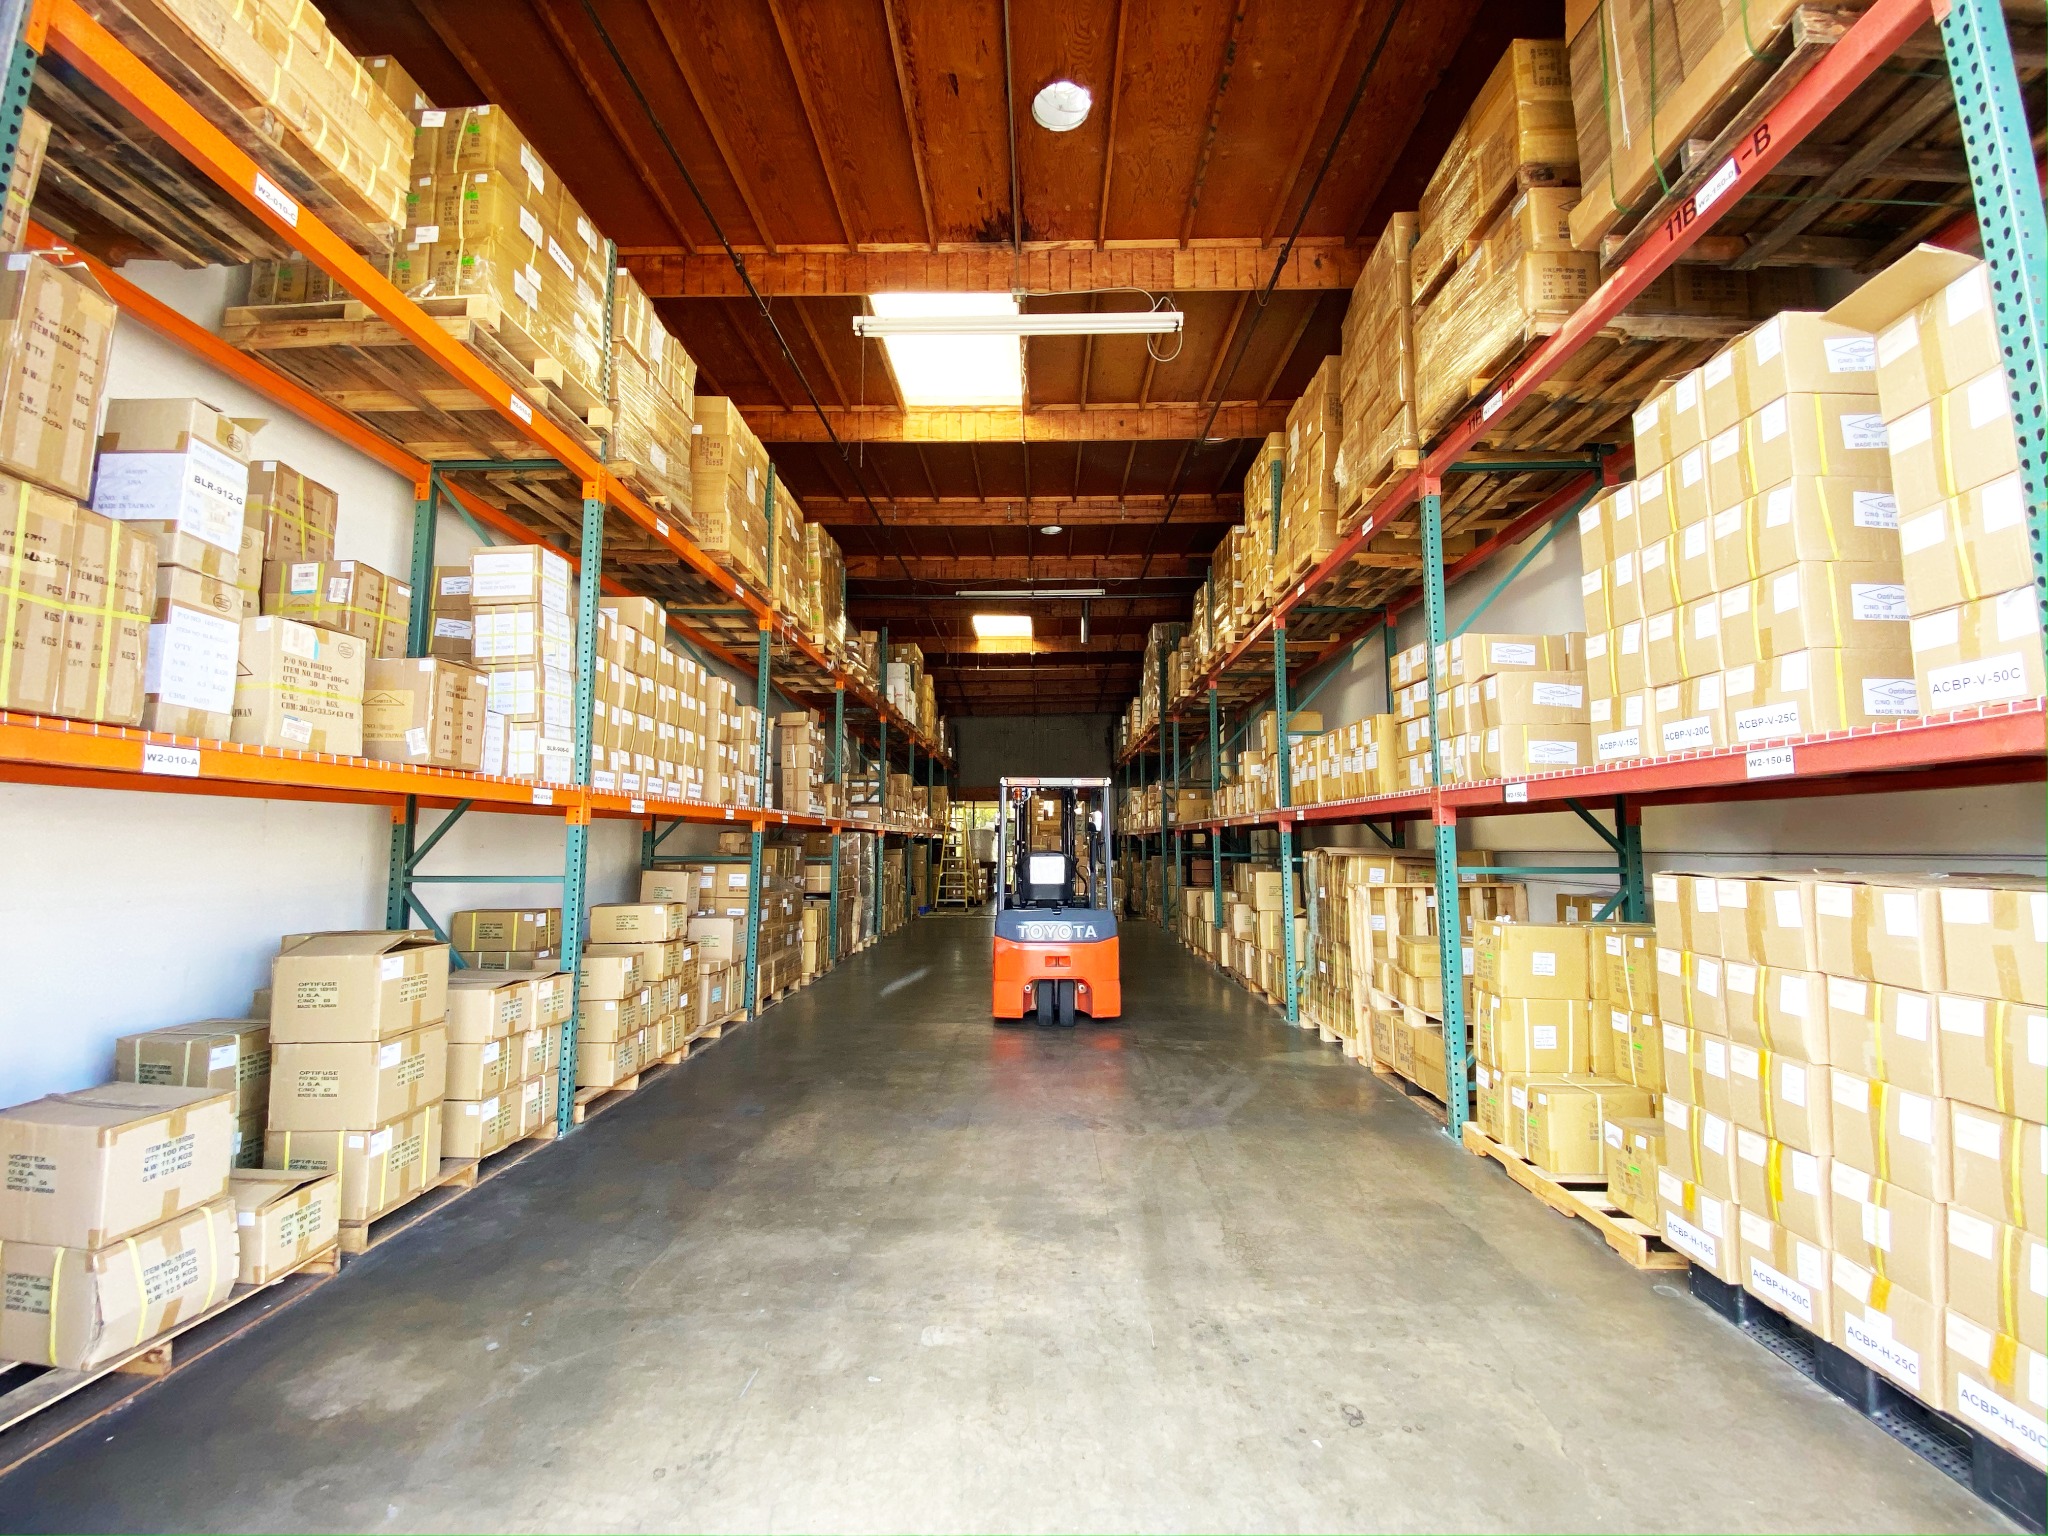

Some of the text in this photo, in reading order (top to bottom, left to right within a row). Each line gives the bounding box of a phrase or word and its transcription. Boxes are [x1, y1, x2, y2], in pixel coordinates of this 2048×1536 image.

[194, 475, 243, 505] BLR-912-G
[47, 584, 63, 596] PCS
[44, 611, 60, 622] KGS
[42, 636, 57, 646] KGS
[283, 665, 300, 675] ITEM
[1932, 668, 2021, 694] ACBP-V-50C
[1738, 713, 1797, 730] ACBP-V-25C
[1665, 726, 1710, 741] ACBP-V-20C
[1599, 737, 1638, 750] ACBP-V-15C
[147, 752, 198, 766] W2-010-A
[1749, 754, 1791, 767] W2-150-B
[1016, 924, 1097, 939] TOYOTA
[145, 1145, 161, 1154] ITEM
[163, 1148, 177, 1157] 100
[178, 1142, 194, 1152] PCS
[9, 1154, 46, 1162] VORTEX
[161, 1157, 176, 1167] 11.5
[178, 1151, 193, 1161] KGS
[177, 1160, 192, 1170] KGS
[297, 1214, 308, 1223] 100
[1668, 1221, 1714, 1256] ACBP-H-15C
[144, 1265, 160, 1276] ITEM
[164, 1265, 179, 1276] 100
[181, 1257, 197, 1268] PCS
[165, 1274, 180, 1285] 11.5
[182, 1266, 198, 1277] KGS
[166, 1284, 181, 1295] 12.5
[183, 1275, 198, 1287] KGS
[1753, 1269, 1809, 1309] ACBP-H-20C
[1847, 1326, 1917, 1375] ACBP-H-25C
[1961, 1389, 2047, 1448] ACBP-H-50C
